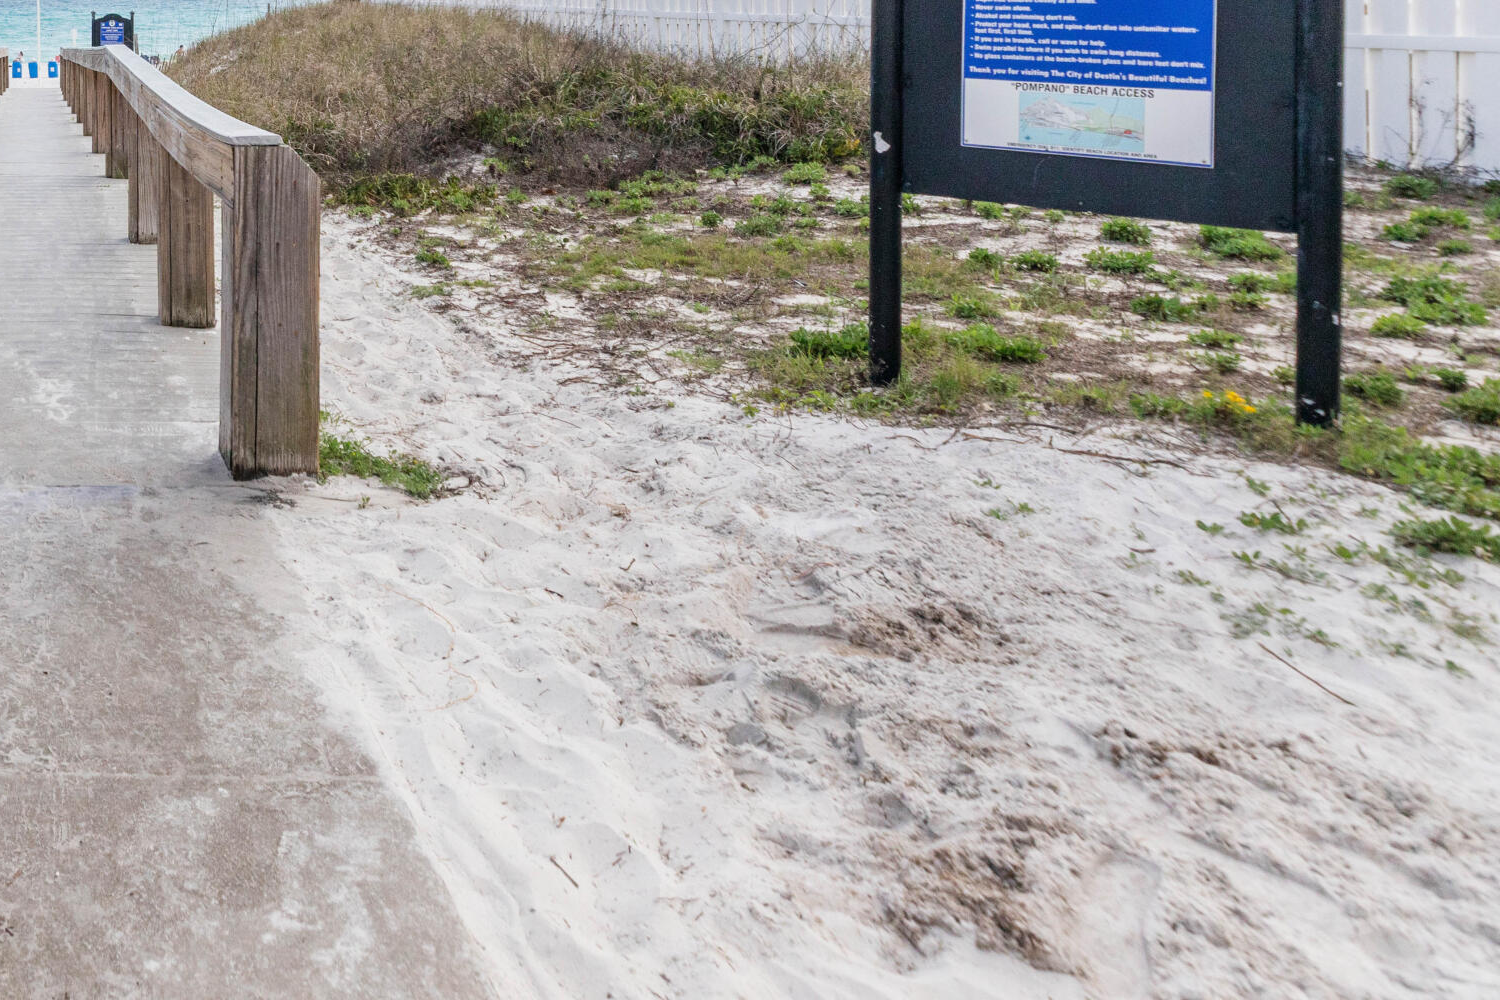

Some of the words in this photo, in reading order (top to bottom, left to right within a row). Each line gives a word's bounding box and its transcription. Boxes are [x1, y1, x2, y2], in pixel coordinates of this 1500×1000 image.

[1021, 69, 1049, 78] visiting
[1066, 70, 1082, 79] City
[1094, 72, 1126, 80] Destin's
[1128, 74, 1168, 82] Beautiful
[1169, 76, 1207, 84] Beaches!
[1011, 82, 1070, 94] "POMPANO"
[1073, 86, 1108, 96] BEACH
[1112, 88, 1154, 98] ACCESS
